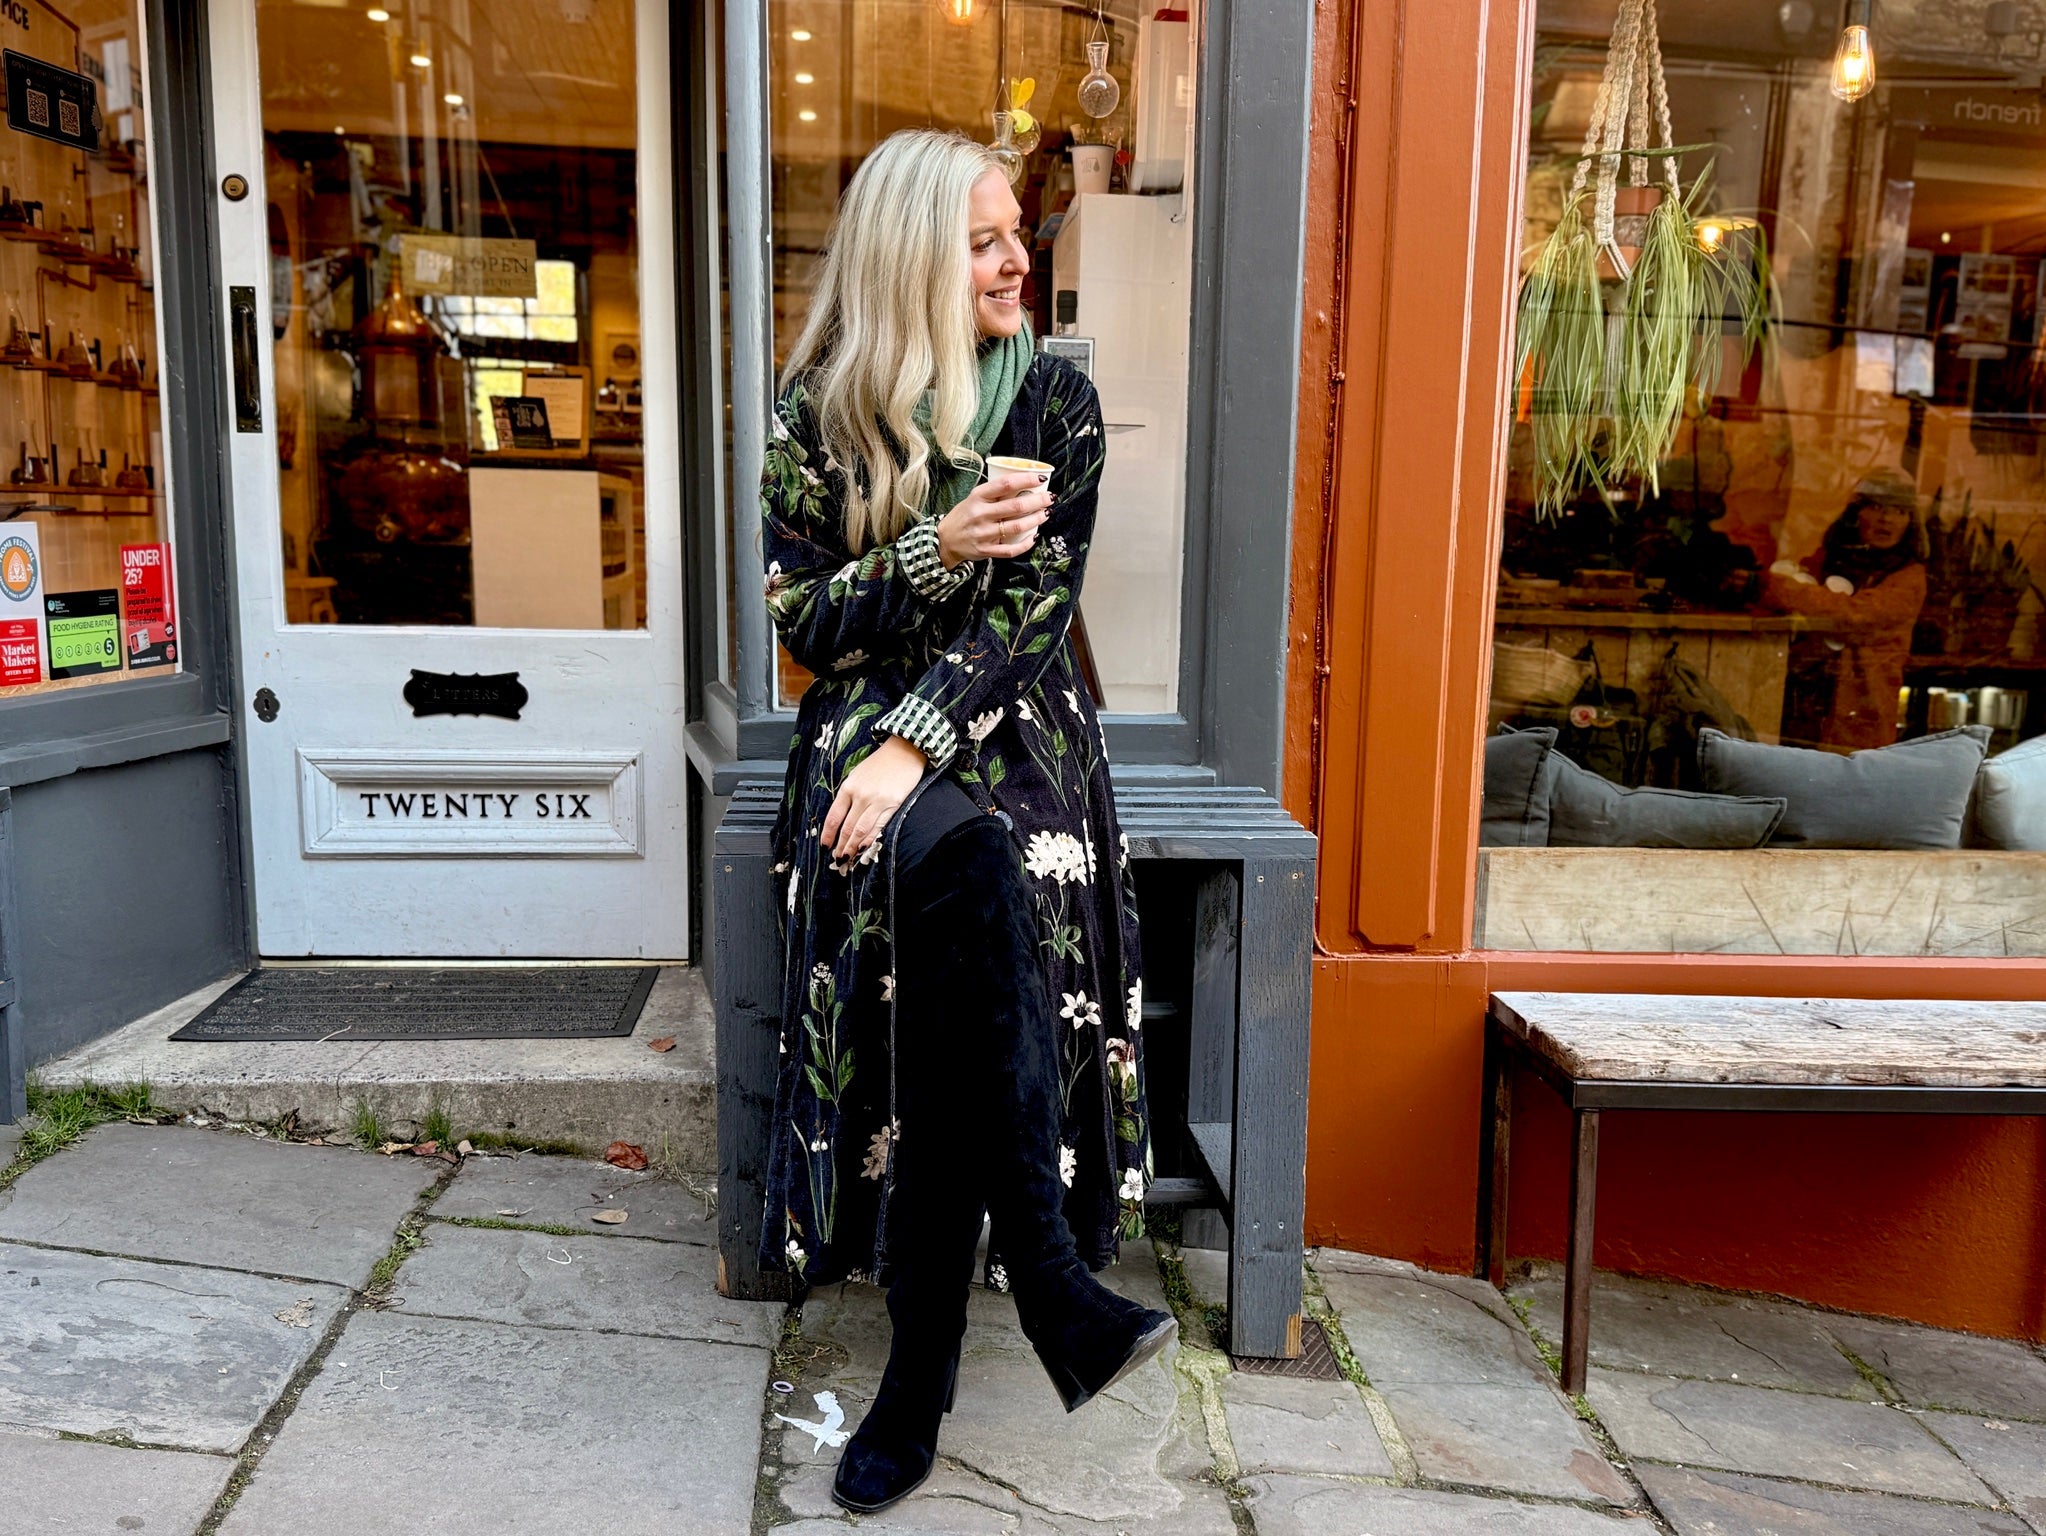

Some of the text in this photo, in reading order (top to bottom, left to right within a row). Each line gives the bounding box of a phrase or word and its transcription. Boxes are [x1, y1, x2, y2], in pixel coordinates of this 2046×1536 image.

[471, 256, 529, 273] OPEN
[13, 538, 36, 563] FESTIVAL
[123, 549, 160, 567] UNDER
[125, 568, 143, 585] 25?
[53, 619, 114, 632] FOOD HYGIENE RATING
[1, 643, 35, 656] Market
[106, 640, 113, 654] 5
[1, 655, 37, 668] Makers
[360, 793, 592, 818] TWENTY SIX
